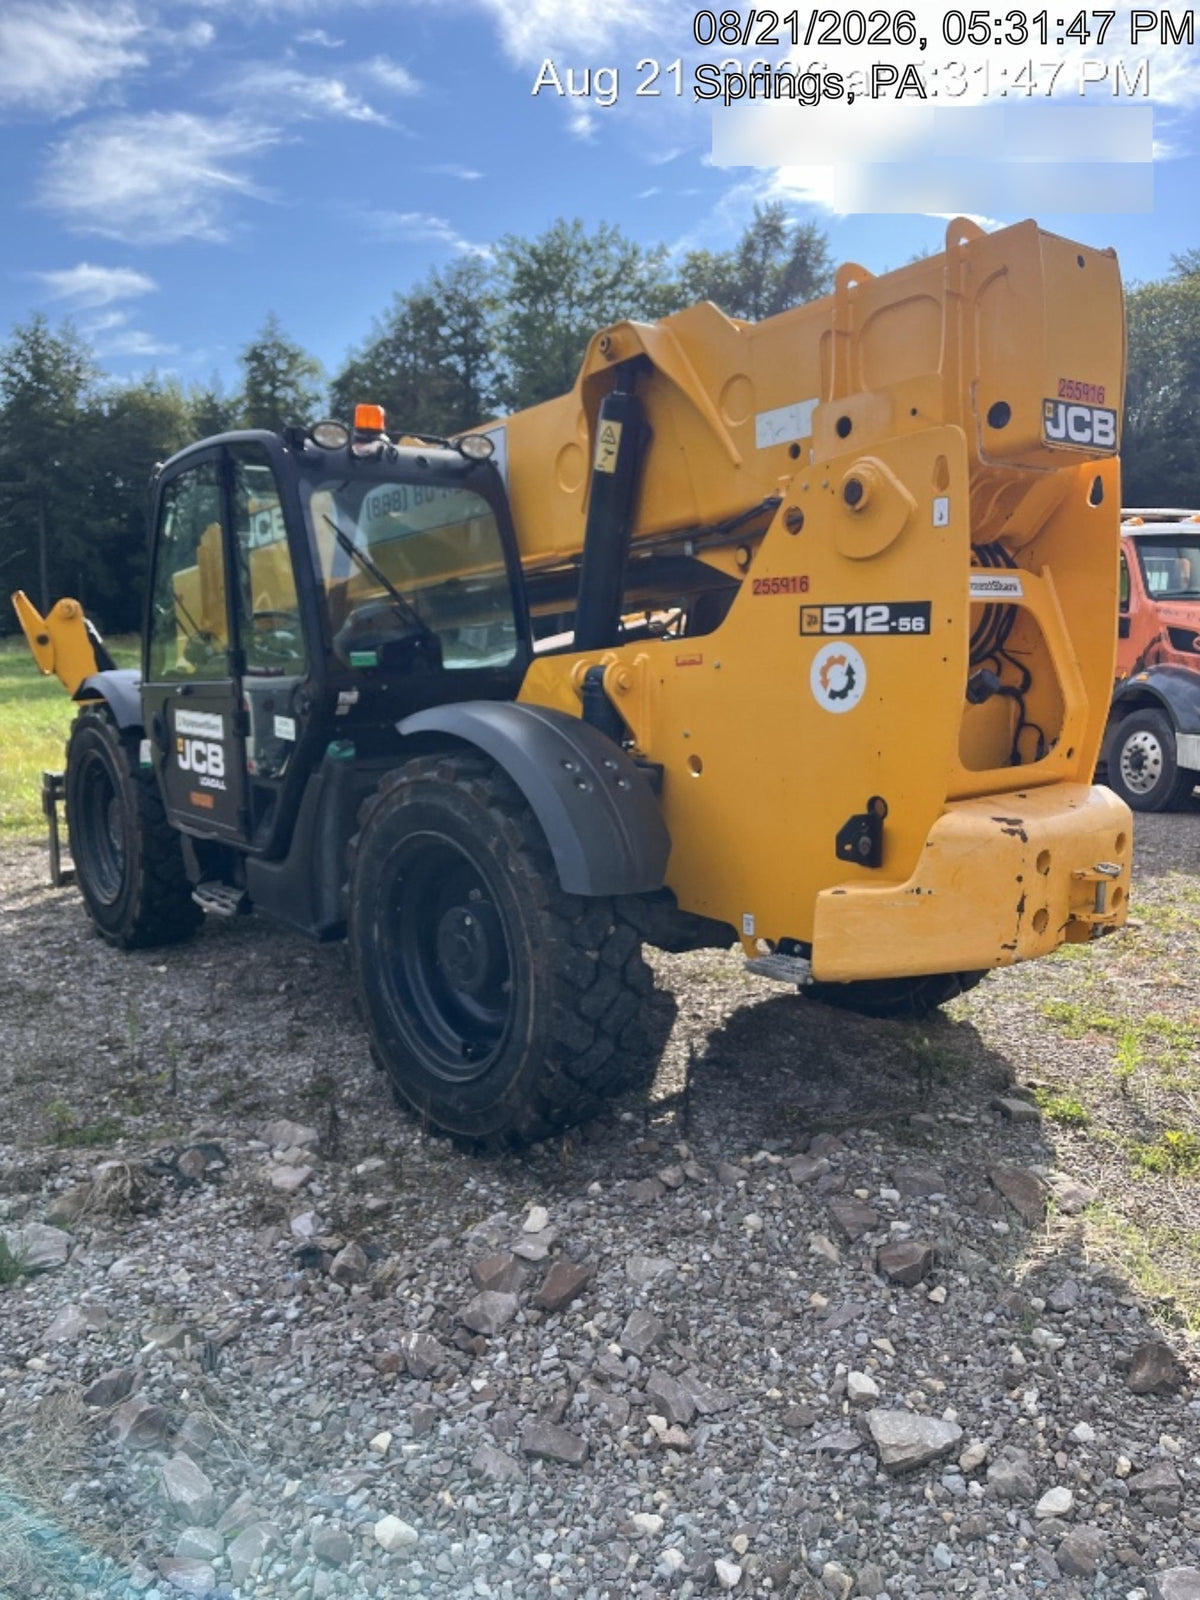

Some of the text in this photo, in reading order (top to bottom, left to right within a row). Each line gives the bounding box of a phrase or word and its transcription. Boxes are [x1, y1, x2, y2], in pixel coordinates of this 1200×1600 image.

[1057, 378, 1106, 405] 255916
[1045, 403, 1116, 446] JCB
[752, 576, 810, 596] 255916
[822, 606, 925, 634] 512-56
[175, 737, 225, 777] JCB
